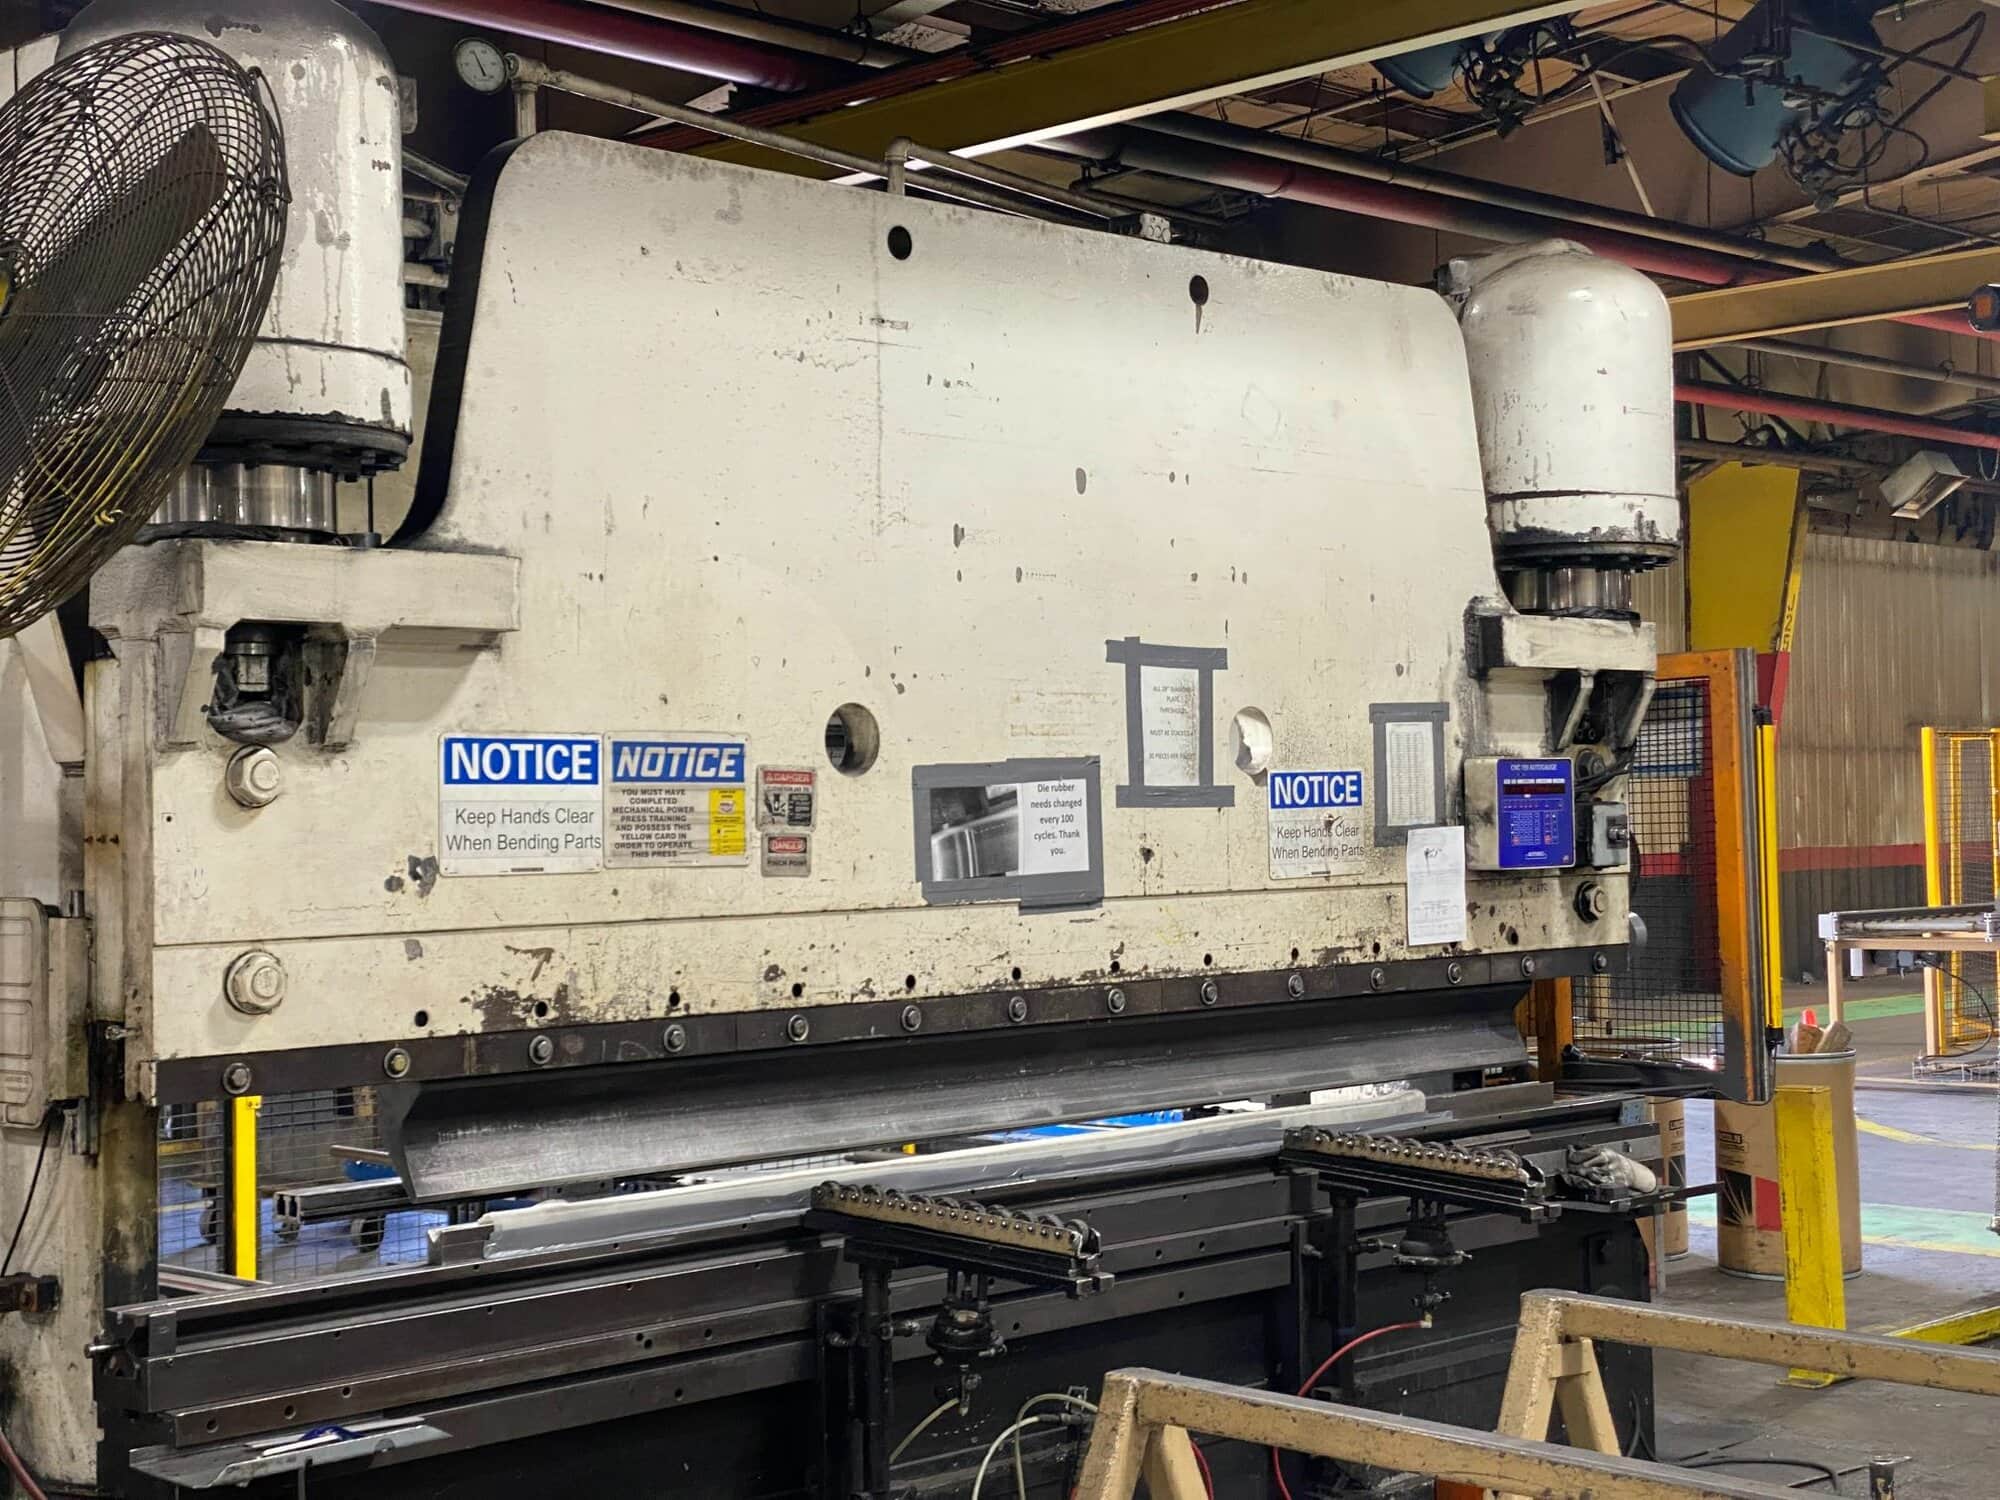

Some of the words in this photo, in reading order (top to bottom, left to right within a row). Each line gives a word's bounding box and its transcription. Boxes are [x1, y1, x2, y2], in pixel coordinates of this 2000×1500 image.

[451, 742, 593, 781] NOTICE
[616, 746, 740, 778] NOTICE
[621, 788, 638, 796] YOU
[640, 788, 663, 796] MUST
[664, 788, 686, 796] HAVE
[1037, 784, 1050, 792] Die
[1051, 783, 1075, 792] rubber
[1274, 775, 1359, 805] NOTICE
[1031, 799, 1052, 808] needs
[1053, 798, 1082, 809] changed
[612, 806, 664, 814] MECHANICAL
[666, 806, 694, 814] POWER
[455, 808, 496, 828] Keep
[501, 807, 550, 825] Hands
[555, 807, 594, 825] Clear
[1040, 816, 1059, 825] every
[1061, 813, 1074, 823] 100
[1034, 830, 1057, 842] cycles.
[1059, 829, 1080, 838] Thank
[1277, 827, 1300, 840] Keep
[1304, 826, 1333, 837] Hands
[1335, 825, 1359, 837] Clear
[446, 834, 492, 851] When
[497, 833, 559, 853] Bending
[564, 833, 602, 850] Parts
[657, 841, 693, 849] OPERATE
[651, 850, 677, 858] PRESS
[1050, 848, 1066, 856] you.
[1272, 846, 1299, 859] When
[1302, 845, 1338, 859] Bending
[1342, 844, 1365, 856] Parts
